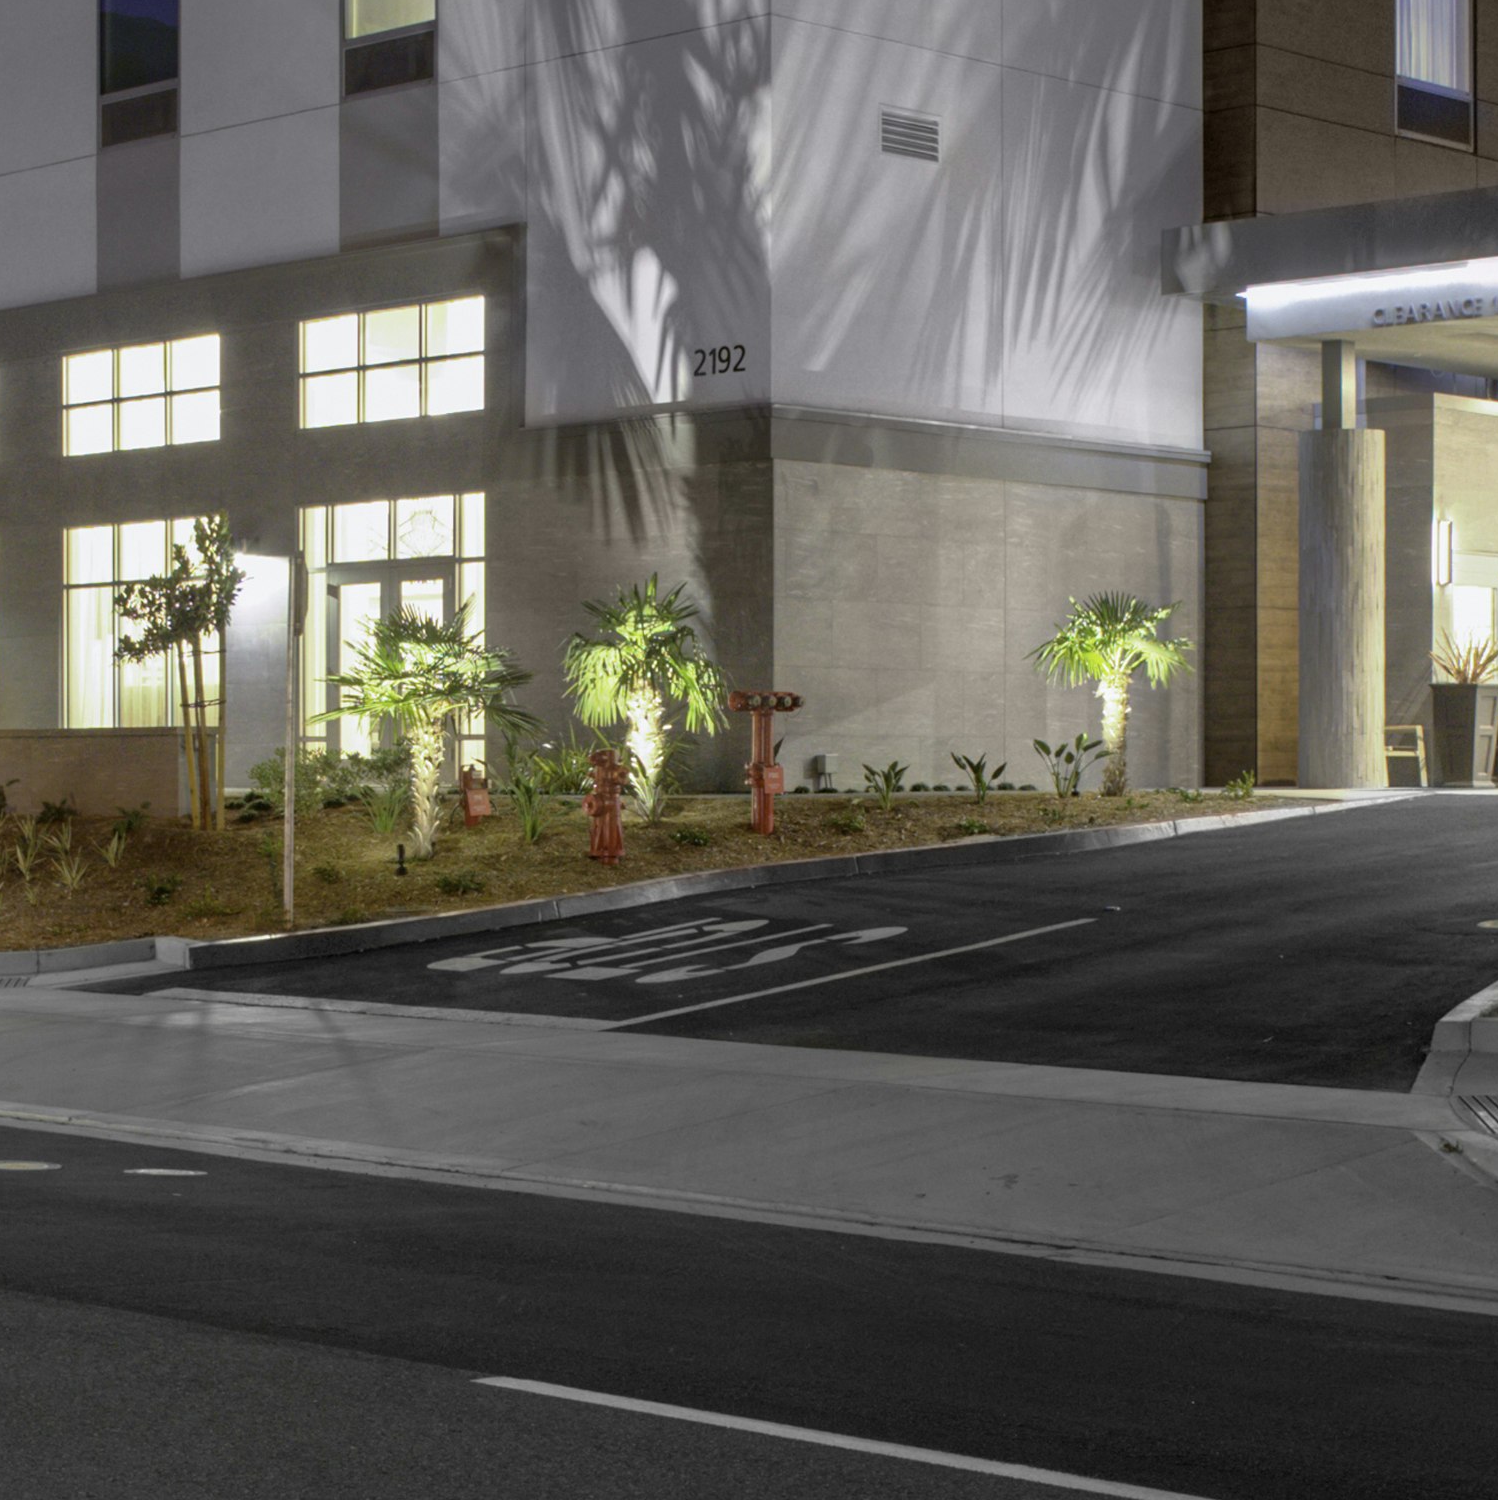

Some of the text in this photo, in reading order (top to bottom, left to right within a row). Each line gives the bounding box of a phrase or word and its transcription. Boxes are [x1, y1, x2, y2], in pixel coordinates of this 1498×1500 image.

[1372, 298, 1483, 327] CLEARANCE
[693, 344, 746, 377] 2192
[426, 916, 910, 985] STOP
